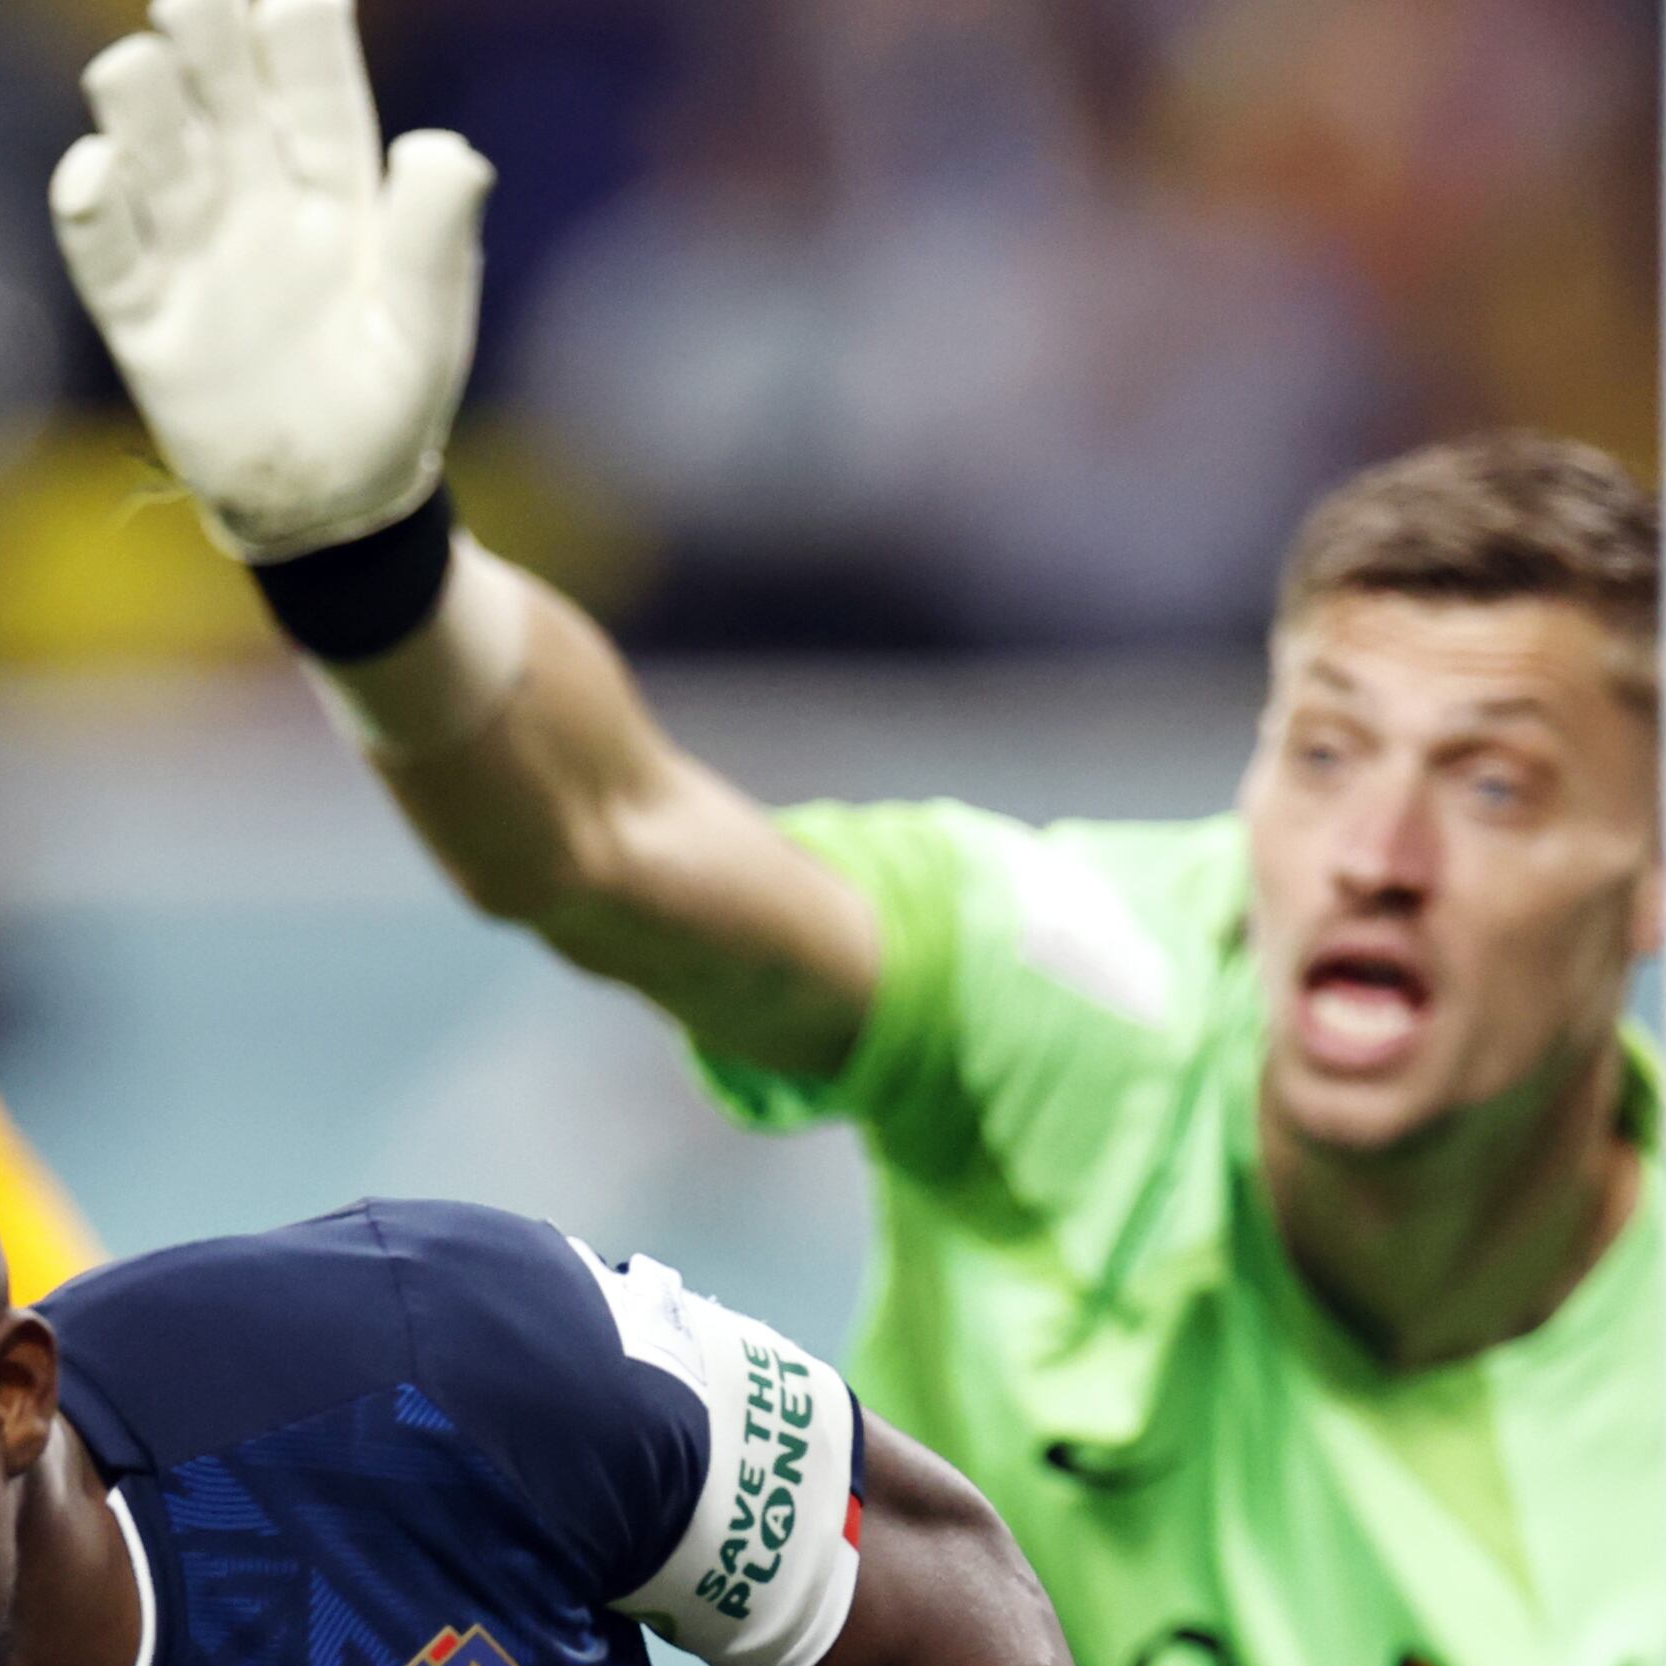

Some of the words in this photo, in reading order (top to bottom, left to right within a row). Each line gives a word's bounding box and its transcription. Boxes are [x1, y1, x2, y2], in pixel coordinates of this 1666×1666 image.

[695, 1460, 767, 1603] SAVE
[742, 1338, 775, 1445] THE
[716, 1347, 813, 1621] PLANET
